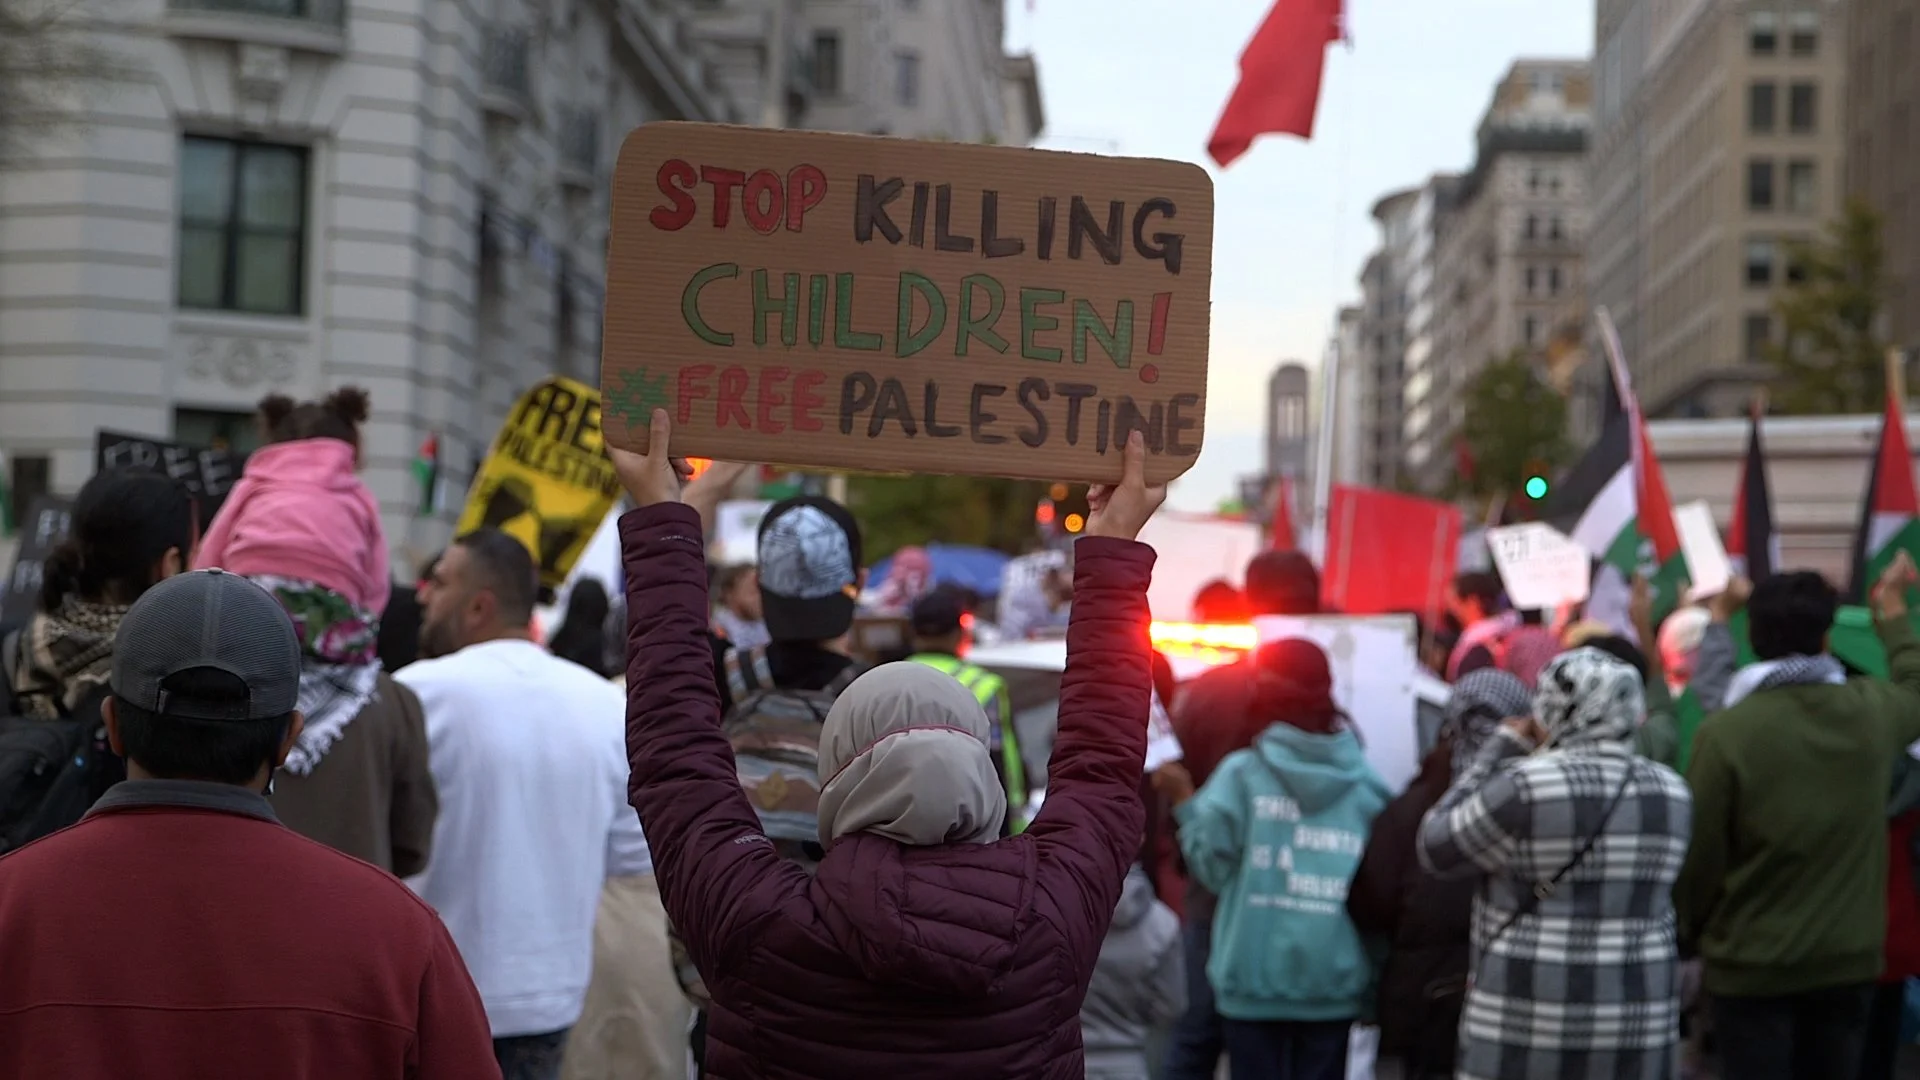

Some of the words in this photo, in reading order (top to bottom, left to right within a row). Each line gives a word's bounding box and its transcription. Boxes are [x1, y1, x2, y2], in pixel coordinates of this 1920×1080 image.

[649, 157, 828, 236] STOP
[853, 173, 1184, 275] KILLING
[680, 262, 1173, 384] CHILDREN!
[518, 382, 611, 462] FRE
[838, 371, 1200, 456] PALESTINE
